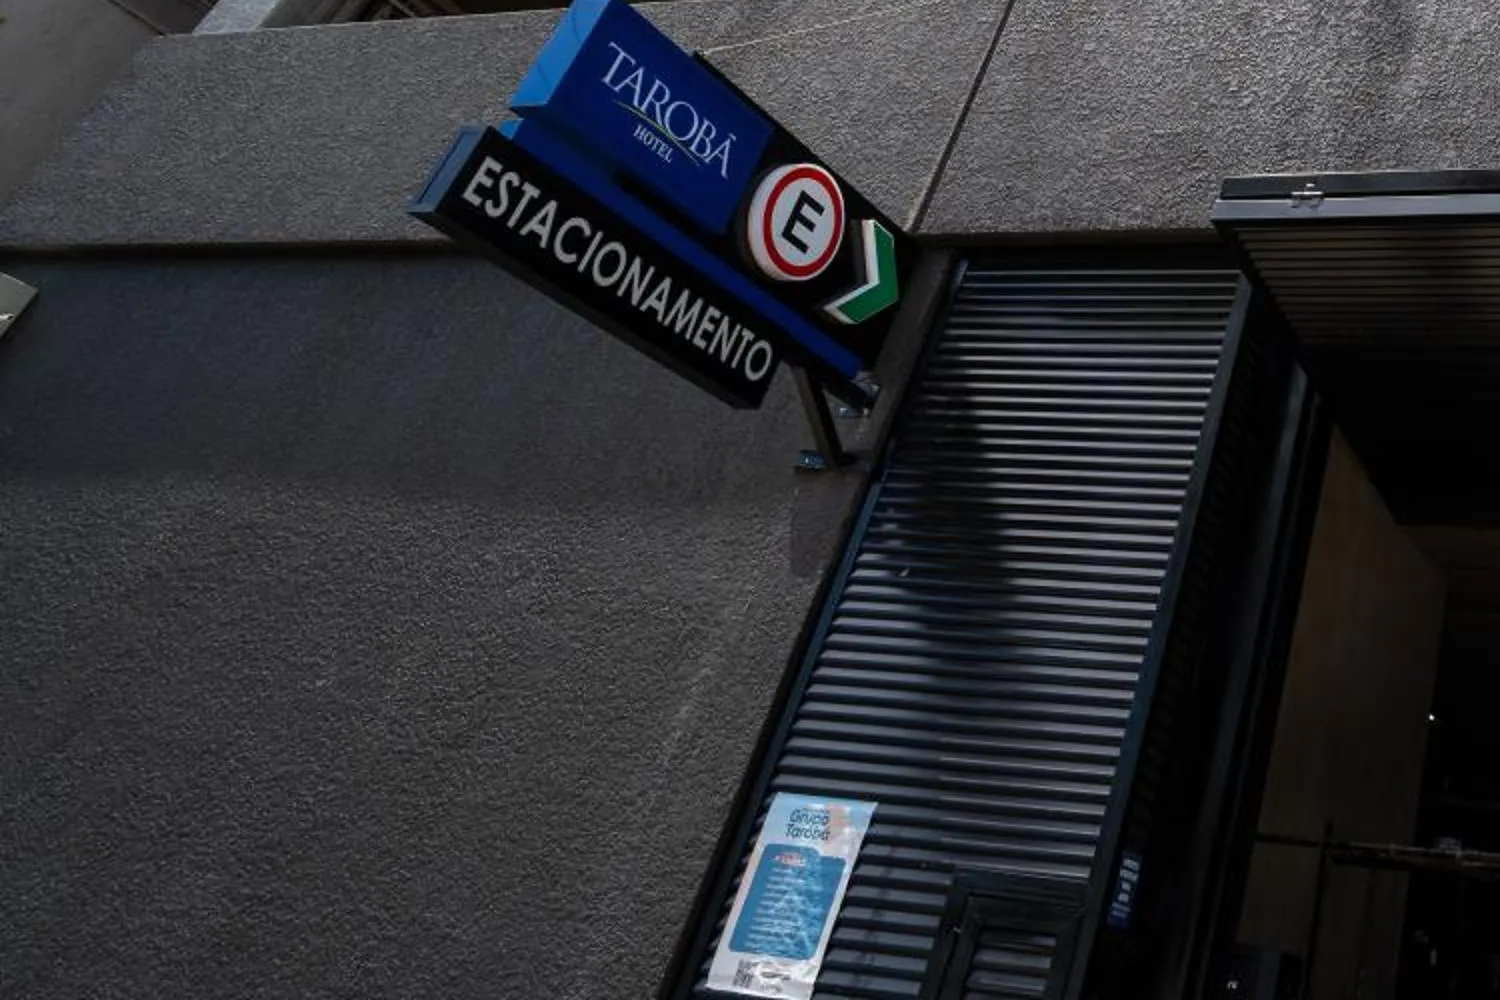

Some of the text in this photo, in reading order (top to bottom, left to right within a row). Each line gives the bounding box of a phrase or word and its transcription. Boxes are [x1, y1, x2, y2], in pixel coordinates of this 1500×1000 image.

[601, 41, 737, 179] TAROBÁ
[633, 123, 674, 164] HOTEL
[462, 156, 774, 382] ESTACIONAMENTO
[782, 190, 828, 254] E
